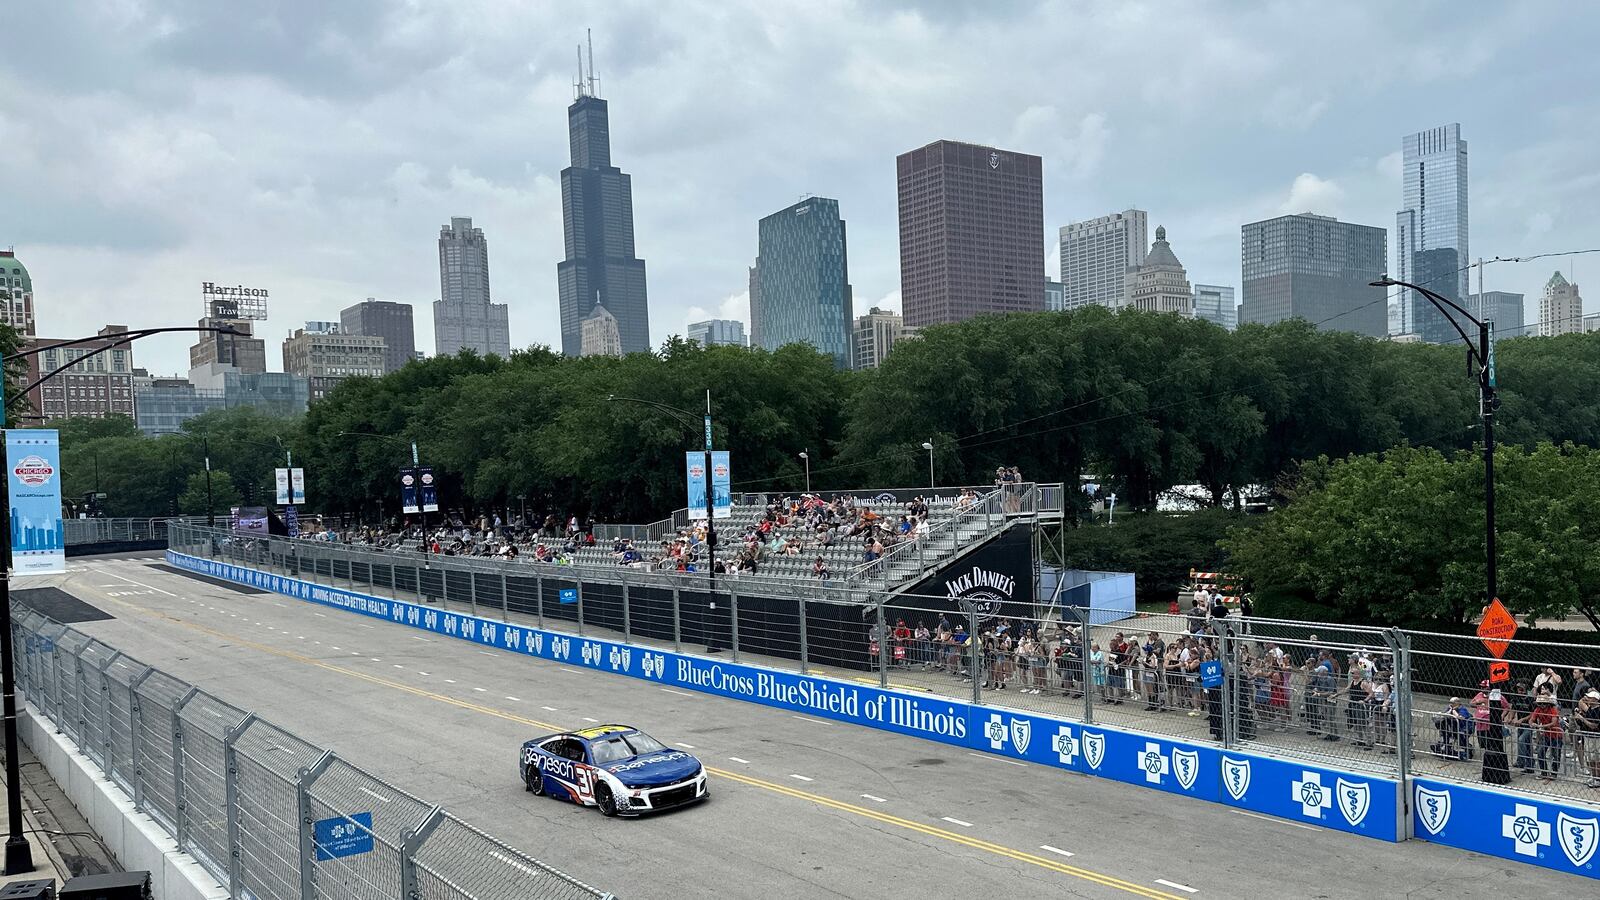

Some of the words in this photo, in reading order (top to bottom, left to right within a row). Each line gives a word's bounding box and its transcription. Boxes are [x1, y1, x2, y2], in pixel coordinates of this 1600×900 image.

[202, 282, 269, 297] Harrison
[945, 573, 973, 602] JACK
[972, 566, 1016, 597] DANIEL'S
[328, 592, 344, 605] ACCESS
[350, 596, 367, 611] BETTER
[367, 600, 388, 617] HEALTH
[1480, 624, 1514, 637] CONSTRUCTION
[1491, 617, 1504, 625] ROAD
[677, 658, 755, 697] BlueCross
[757, 673, 859, 717] BlueShield
[864, 695, 887, 723] of
[889, 697, 967, 739] Illinois
[524, 747, 574, 780] Benesch
[615, 752, 692, 773] Benesch
[575, 763, 595, 797] 31
